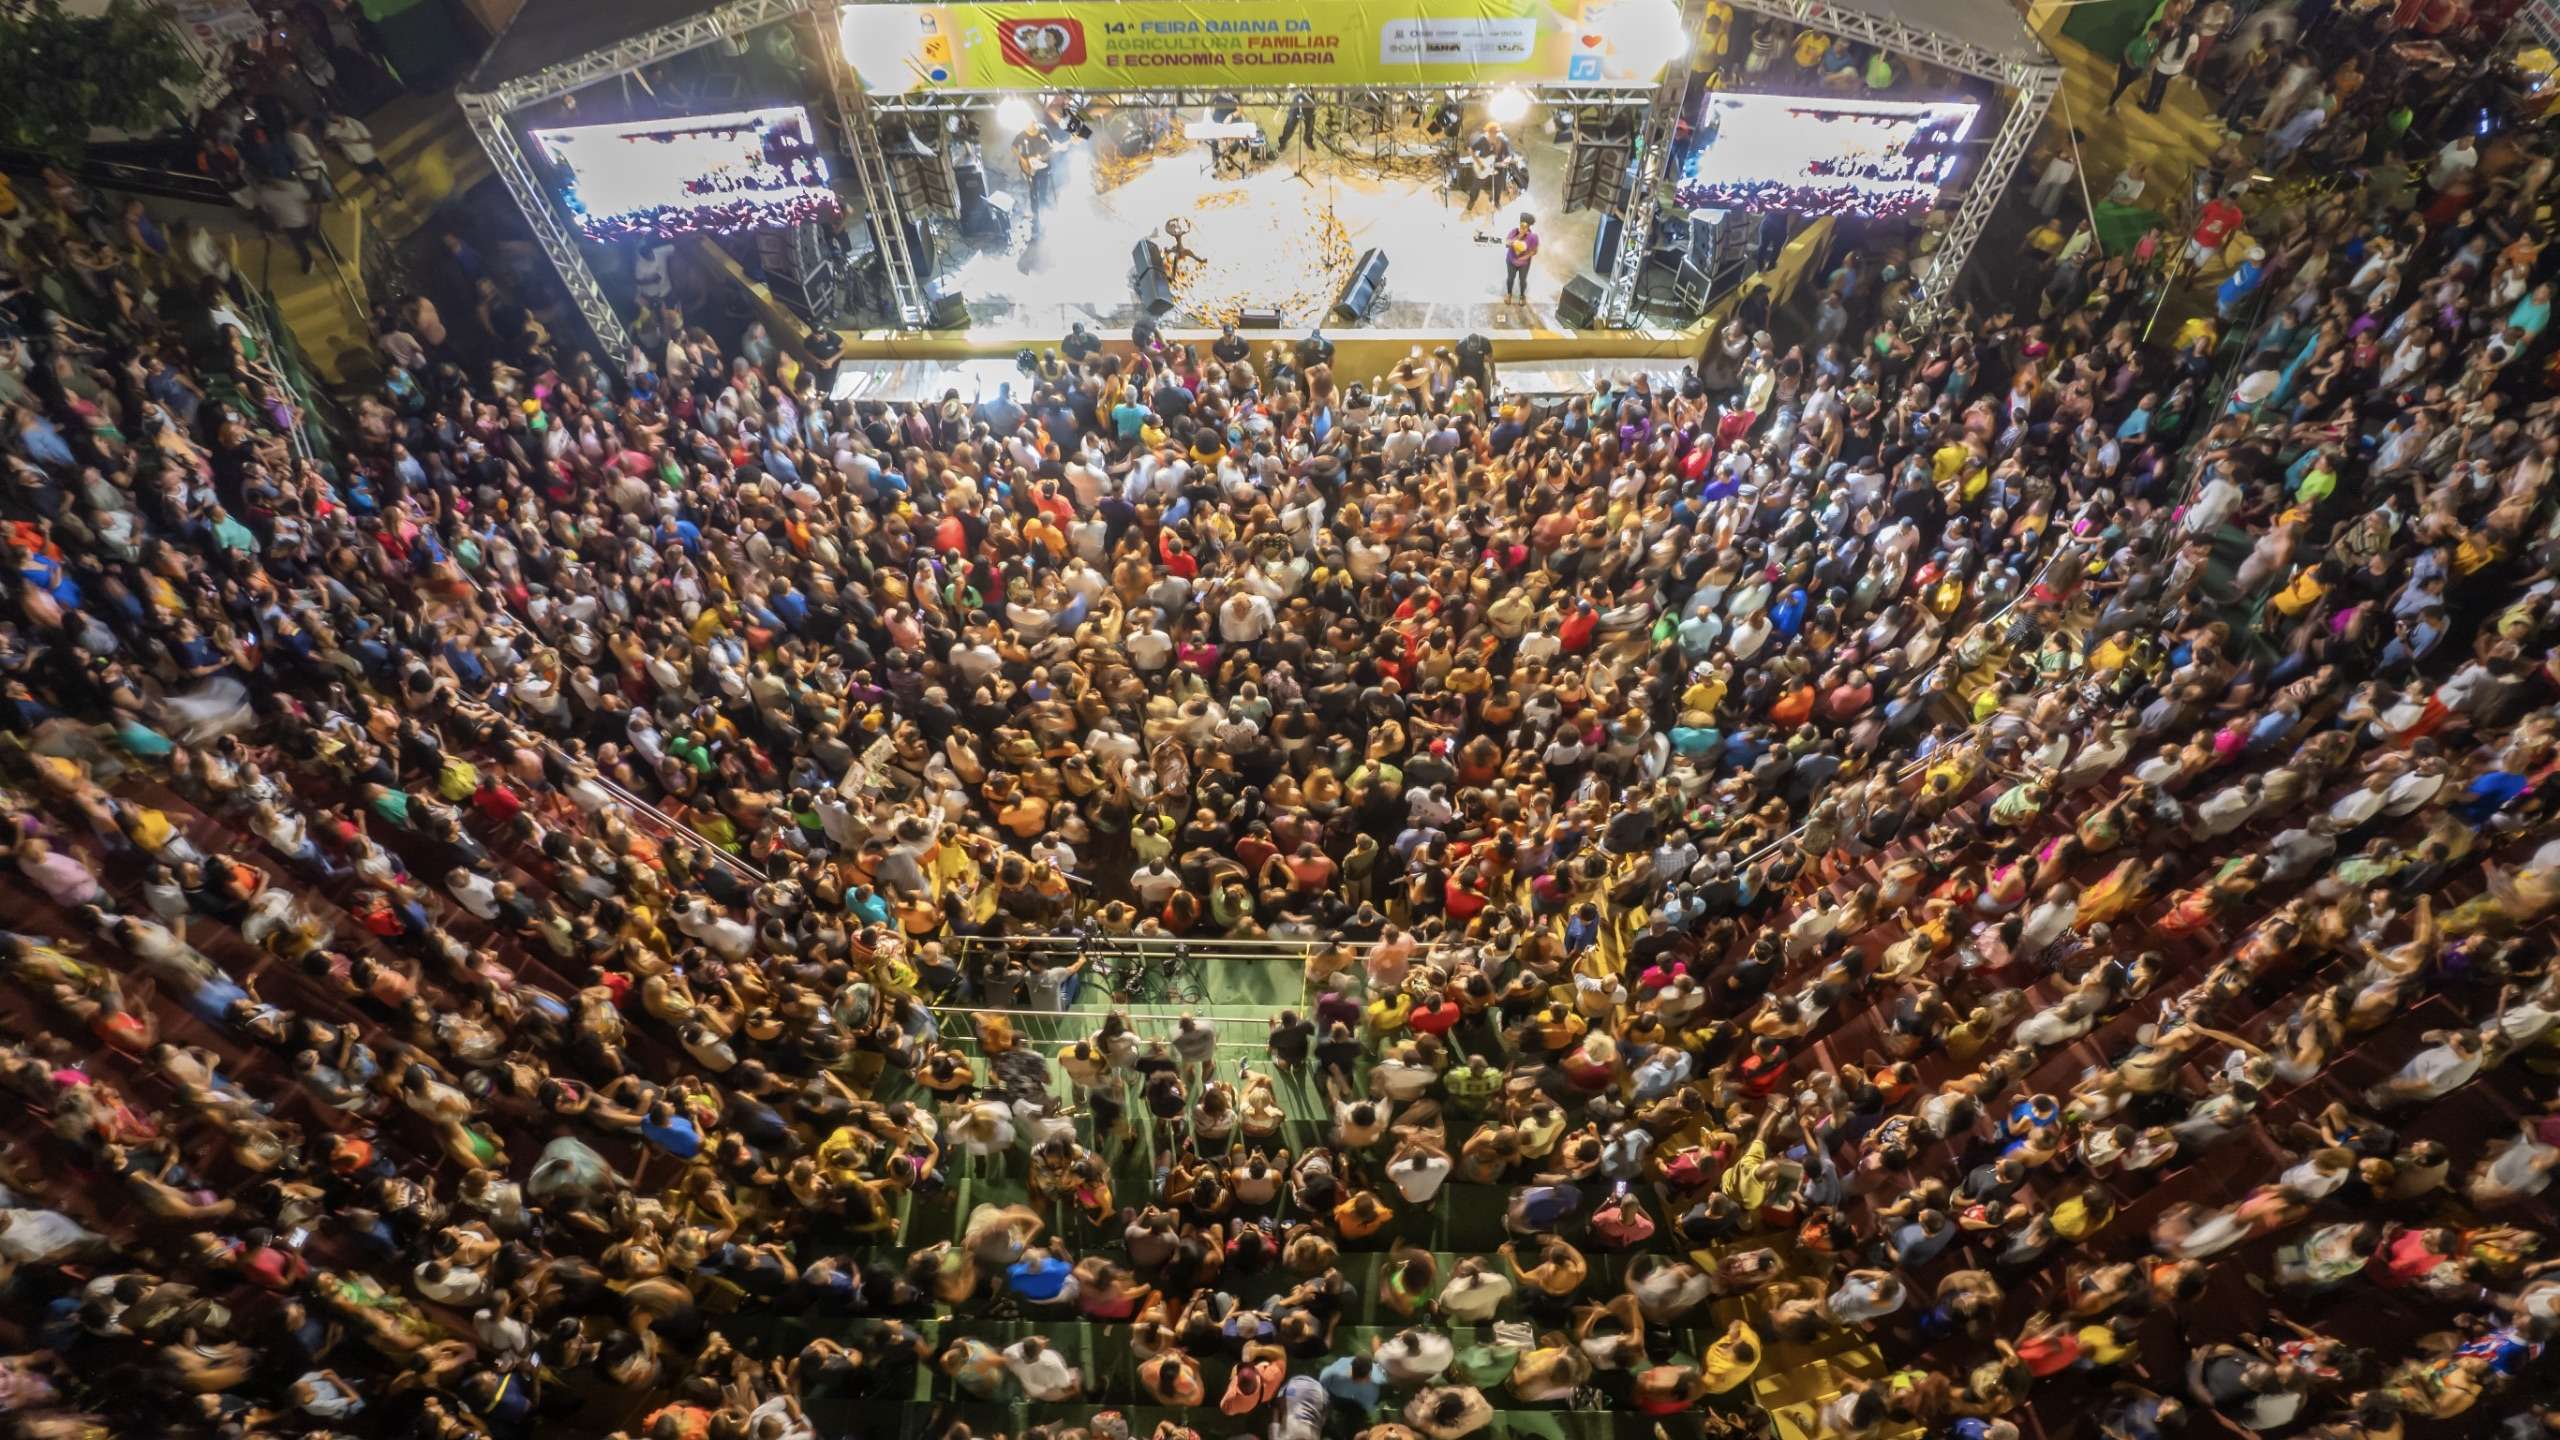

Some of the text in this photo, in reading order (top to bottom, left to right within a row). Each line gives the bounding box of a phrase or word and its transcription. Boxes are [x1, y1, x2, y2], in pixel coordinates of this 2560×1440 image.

[1140, 20, 1200, 33] FEIRA
[1205, 20, 1279, 33] BAIANA
[1285, 19, 1312, 32] DA
[1105, 35, 1339, 50] AGRICULTURA FAMILIAR
[1106, 54, 1120, 66] E
[1124, 53, 1226, 67] ECONOMIA
